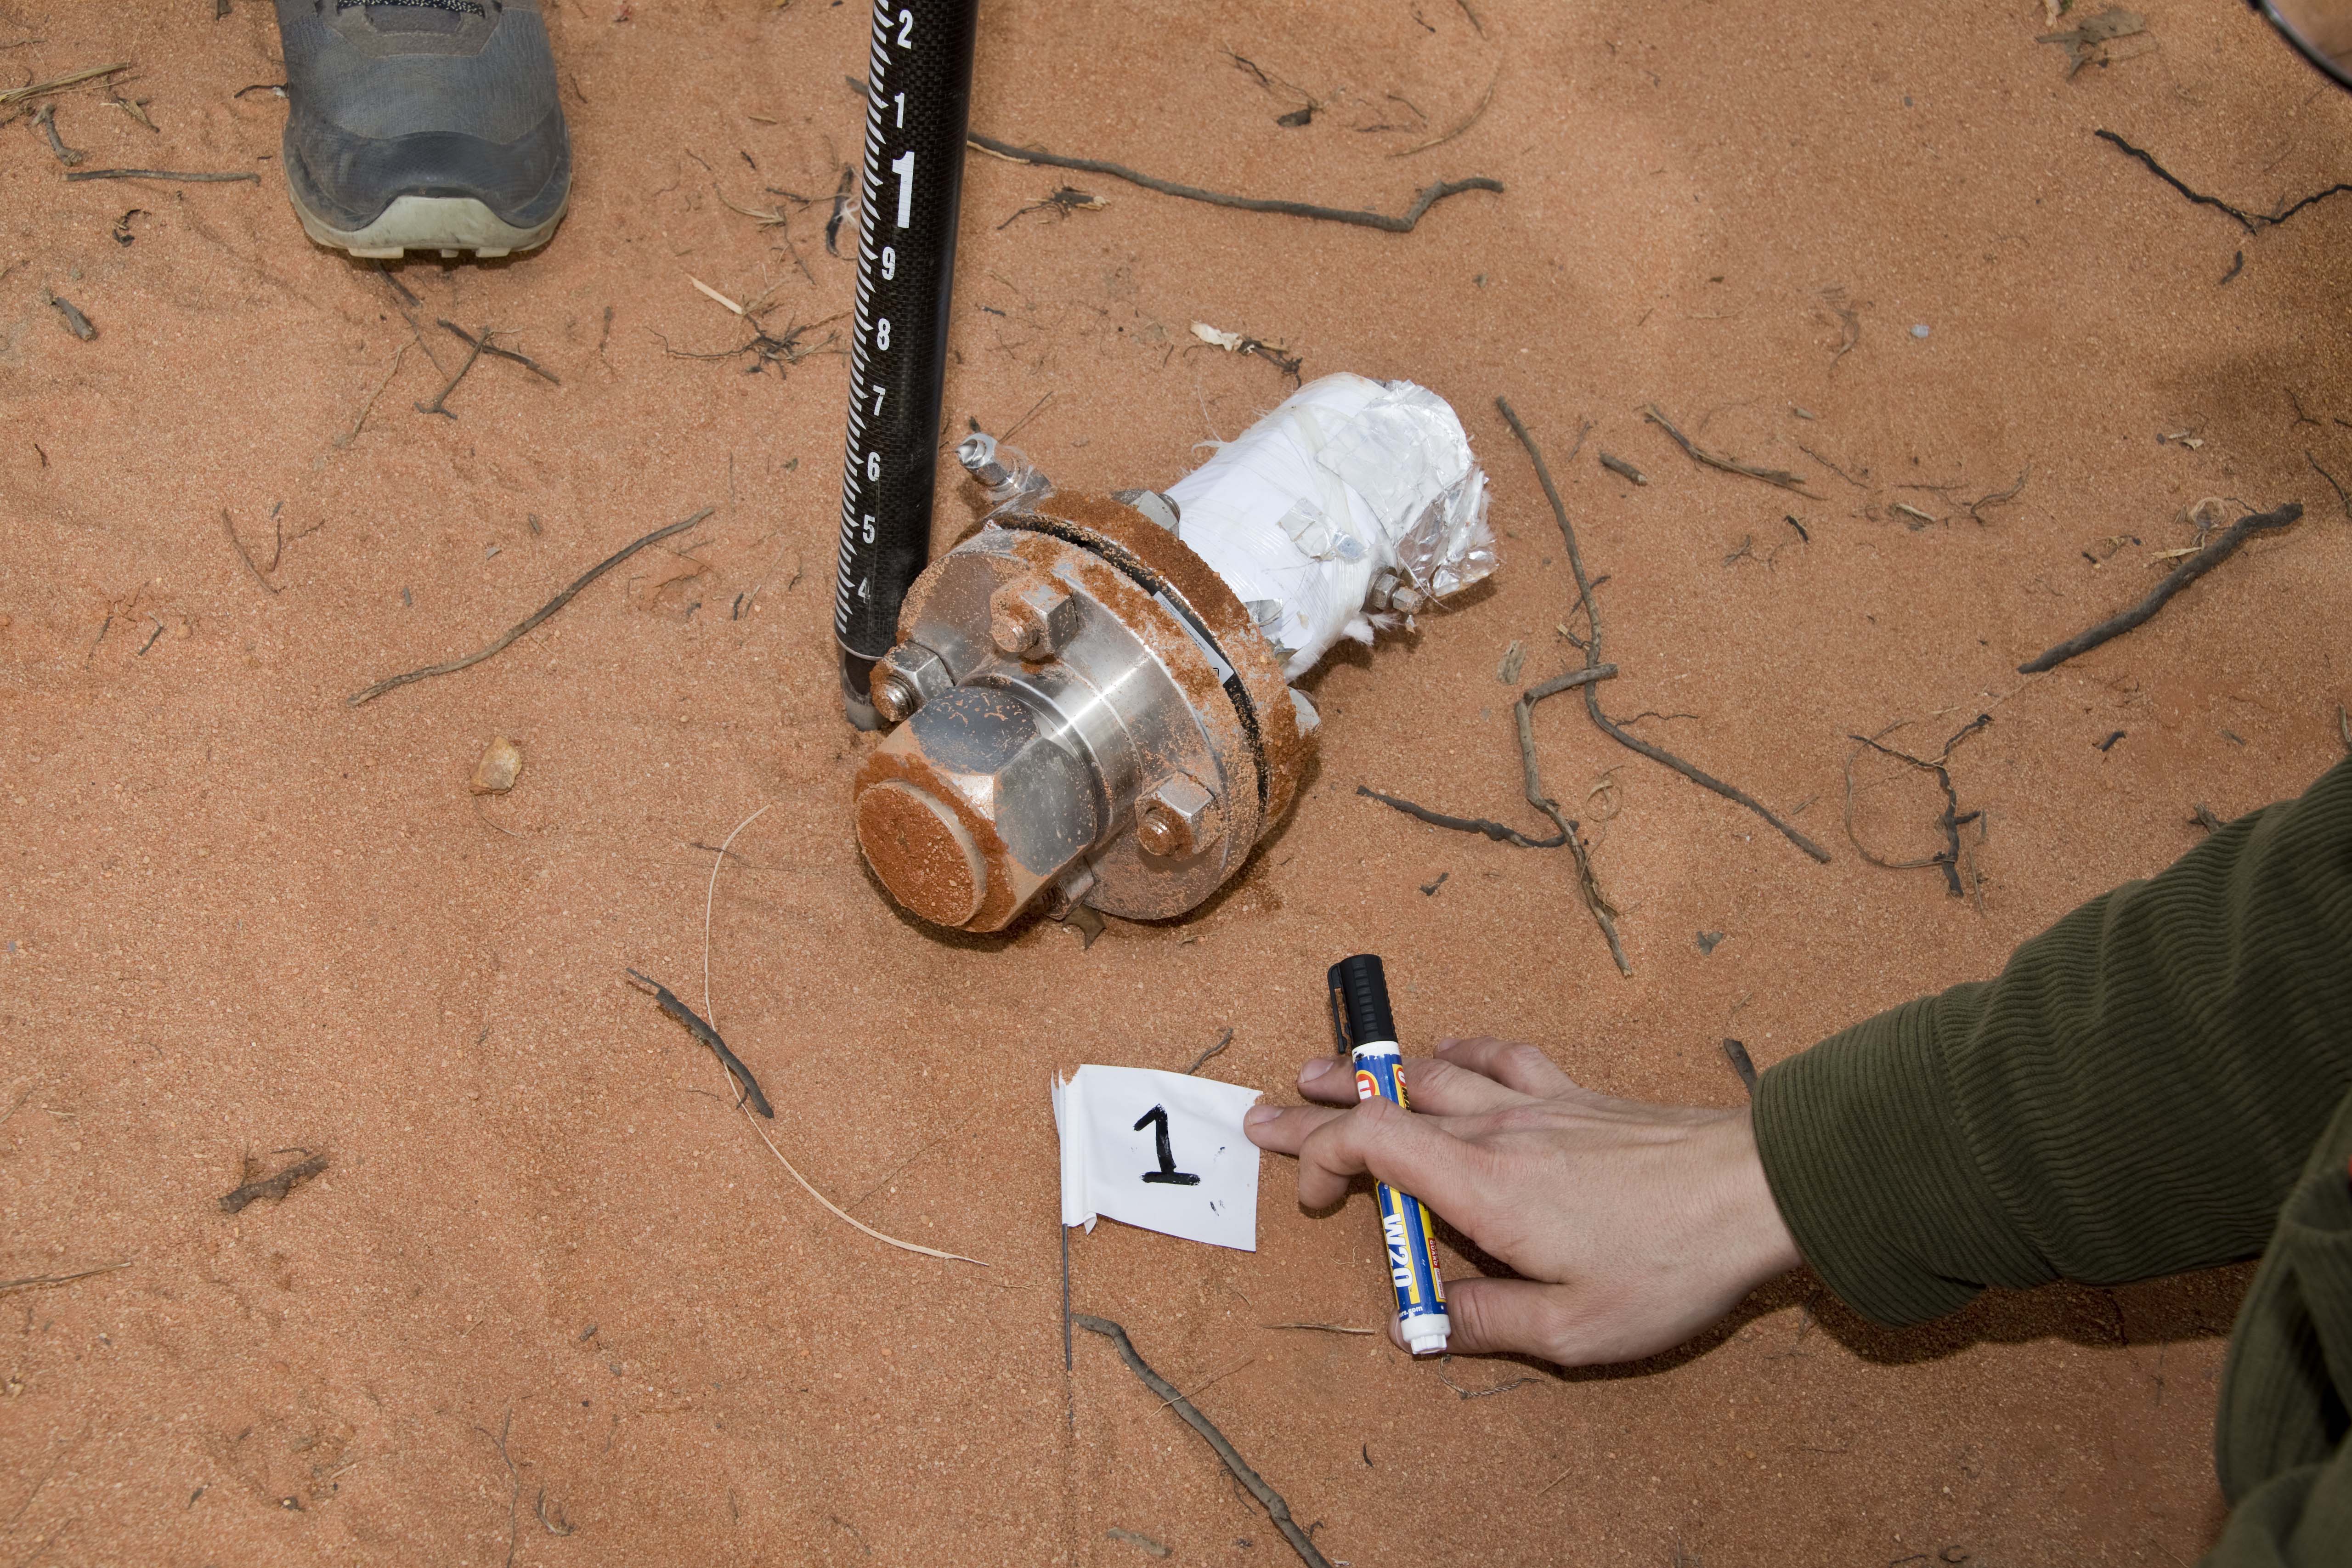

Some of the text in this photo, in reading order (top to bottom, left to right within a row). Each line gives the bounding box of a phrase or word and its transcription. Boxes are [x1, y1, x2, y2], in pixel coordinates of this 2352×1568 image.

[898, 10, 913, 49] 2
[895, 92, 905, 128] 1
[892, 151, 914, 228] 1
[882, 247, 895, 280] 9
[877, 318, 890, 351] 8
[873, 385, 885, 416] 7
[868, 452, 880, 481] 6
[863, 515, 875, 543] 5
[858, 577, 870, 603] 4
[1133, 1103, 1201, 1186] 1
[1384, 1214, 1413, 1287] W20
[1430, 1240, 1438, 1266] GUARD
